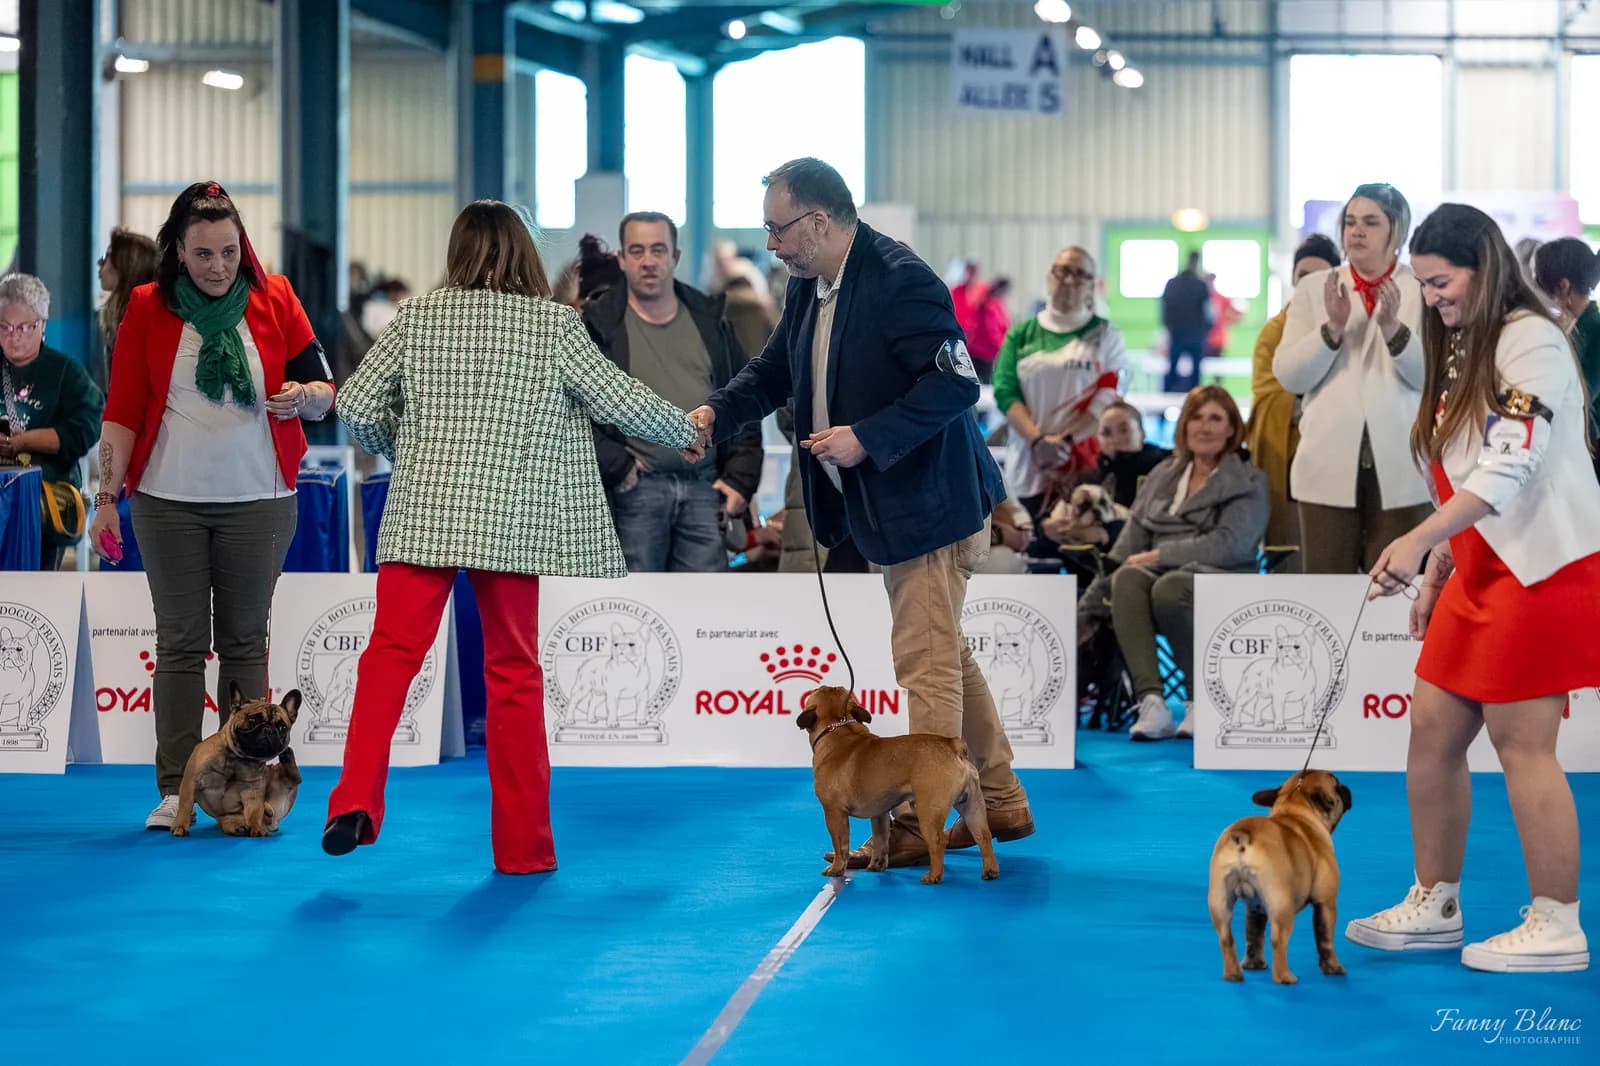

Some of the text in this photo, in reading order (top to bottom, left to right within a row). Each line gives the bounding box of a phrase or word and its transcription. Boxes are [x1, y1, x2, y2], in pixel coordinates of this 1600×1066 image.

[1027, 34, 1061, 78] A
[92, 626, 139, 640] partenariat
[543, 640, 558, 673] CLUB
[553, 624, 569, 640] DU
[567, 601, 649, 624] BOULEDOGUE
[696, 628, 779, 640] En partenariat avec
[1207, 642, 1222, 674] CLUB
[1217, 626, 1235, 642] DU
[1231, 603, 1315, 626] BOULEDOGUE
[1362, 631, 1374, 641] En
[301, 639, 316, 671] CLUB
[312, 623, 328, 639] DU
[323, 635, 366, 652] CBF
[565, 636, 608, 652] CBF
[1229, 638, 1272, 655] CBF
[695, 690, 793, 715] ROYAL
